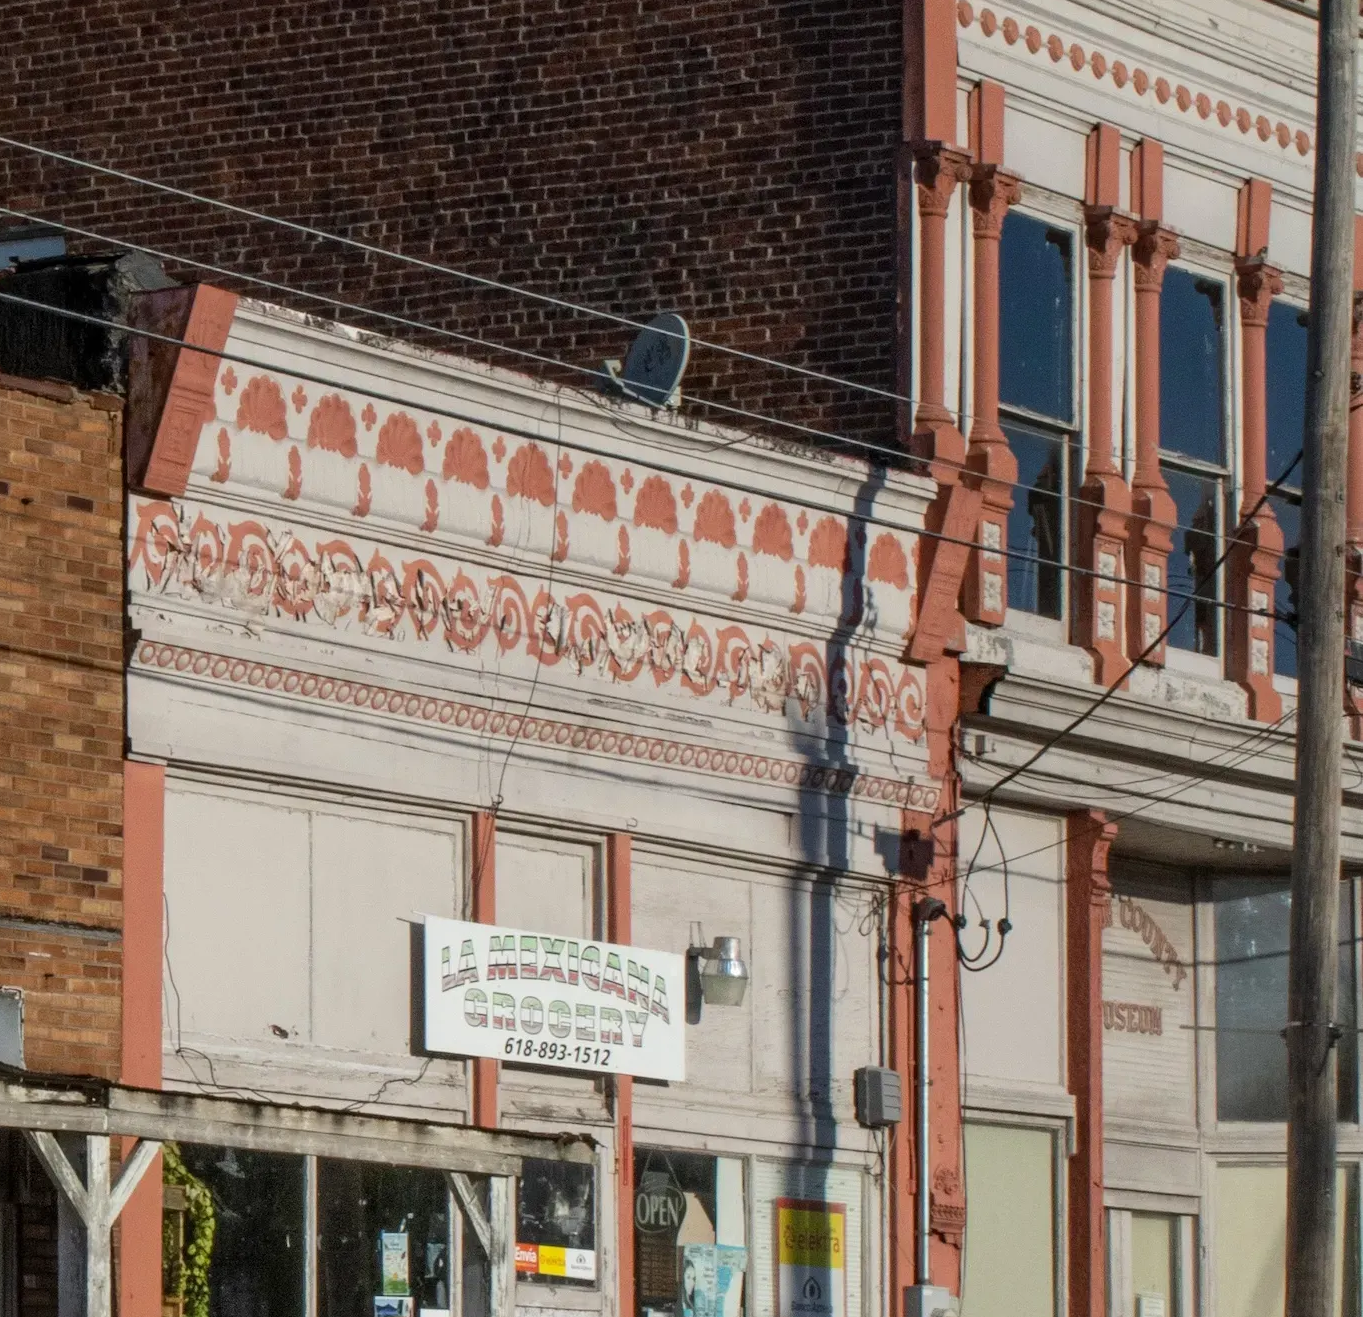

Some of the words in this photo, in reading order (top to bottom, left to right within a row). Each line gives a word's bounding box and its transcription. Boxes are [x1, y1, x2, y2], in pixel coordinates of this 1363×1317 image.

[1119, 897, 1187, 992] COUNTY
[441, 939, 479, 992] LA
[487, 935, 670, 1025] MEXICANA
[464, 988, 649, 1047] GROCERY
[1102, 1000, 1163, 1036] USEUM
[504, 1037, 611, 1067] 618-893-1512
[636, 1193, 679, 1227] OPEN
